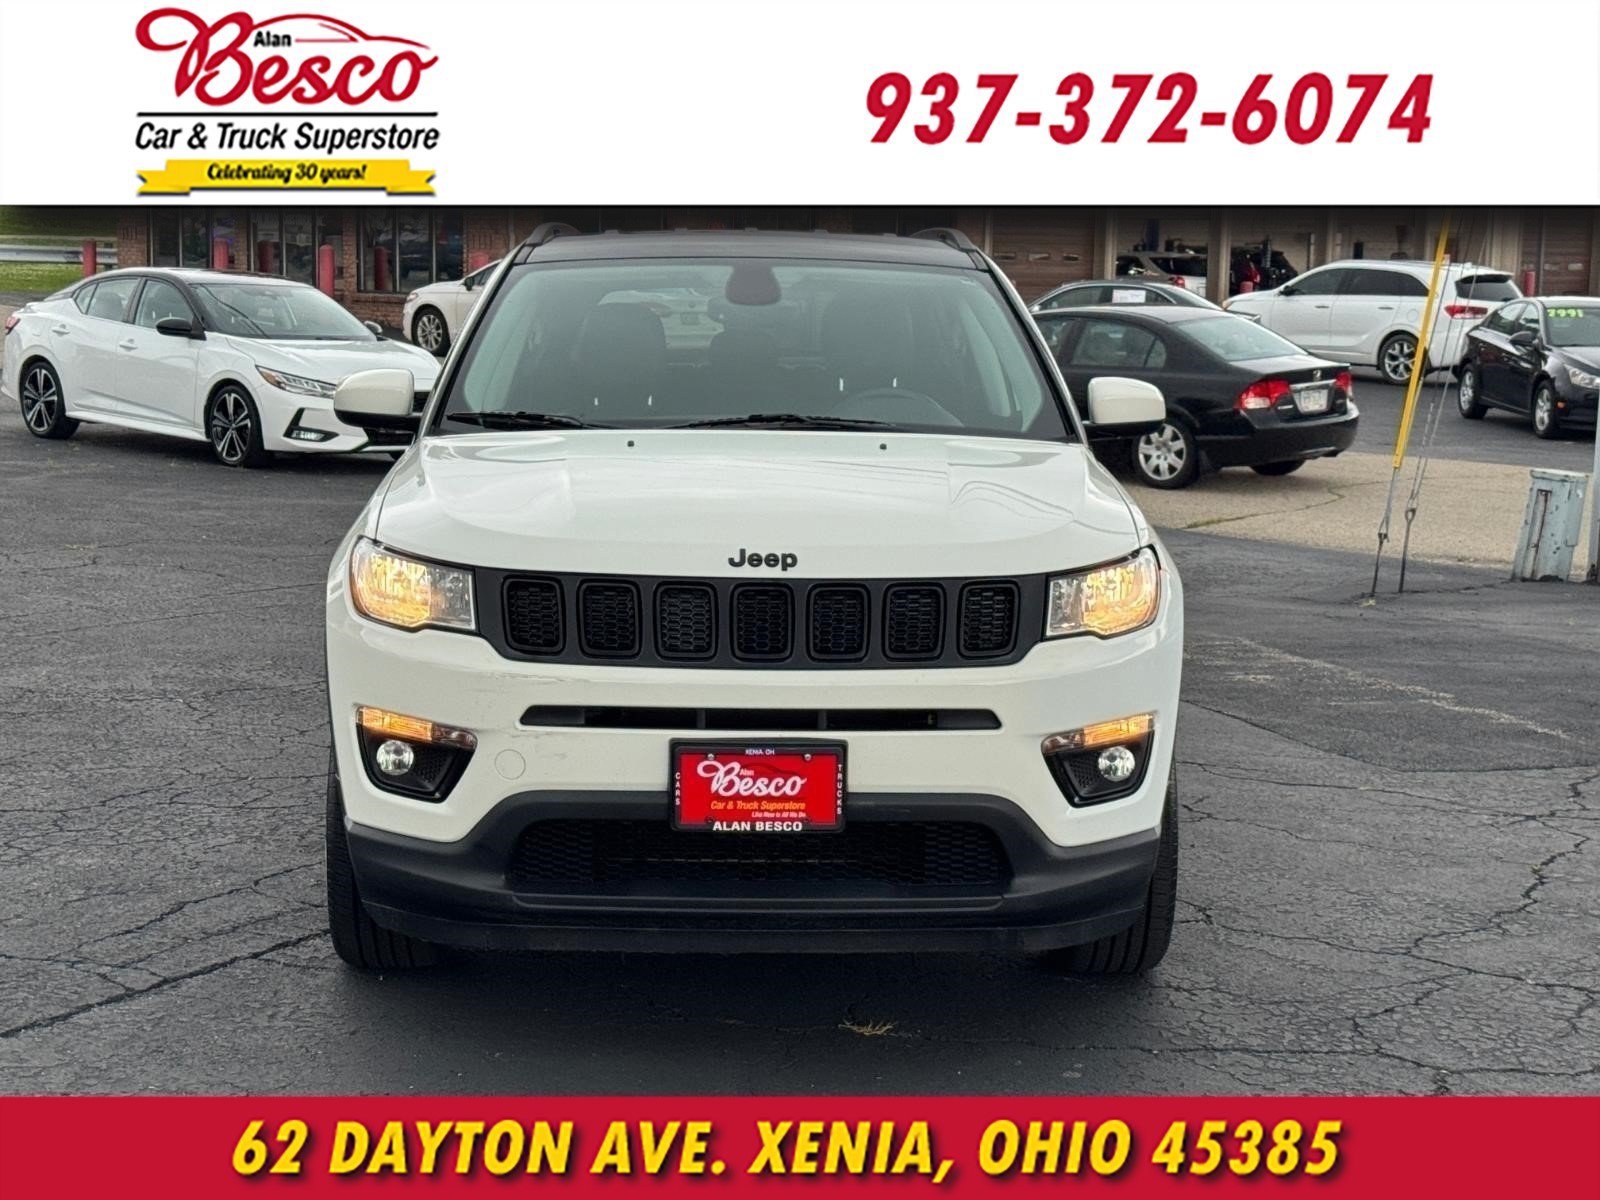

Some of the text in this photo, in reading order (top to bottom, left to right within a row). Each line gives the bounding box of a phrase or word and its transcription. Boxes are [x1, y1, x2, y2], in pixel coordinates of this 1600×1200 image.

[728, 548, 798, 572] Jeep
[740, 768, 755, 776] Alan
[697, 760, 807, 797] Besco
[711, 801, 806, 811] Car & Truck Superstore
[712, 821, 803, 831] ALAN BESCO
